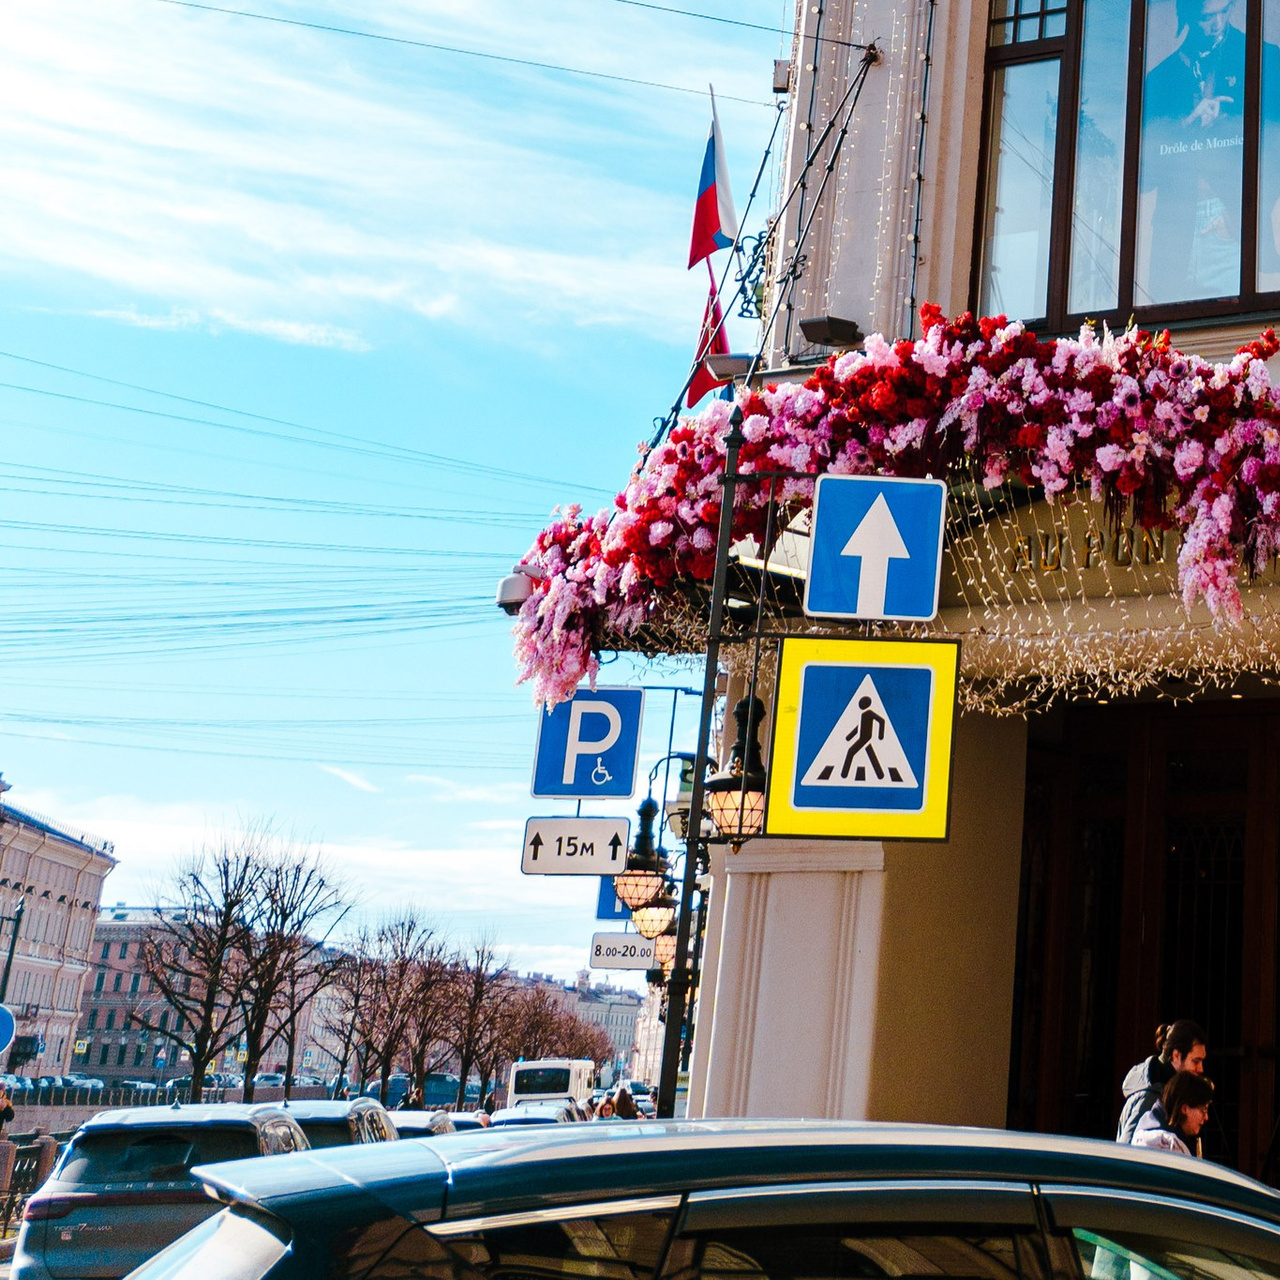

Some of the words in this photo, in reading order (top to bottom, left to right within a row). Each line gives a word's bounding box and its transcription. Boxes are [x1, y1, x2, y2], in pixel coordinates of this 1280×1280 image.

[1190, 139, 1203, 152] de
[562, 700, 622, 785] P
[594, 944, 652, 958] 8.00-20.00
